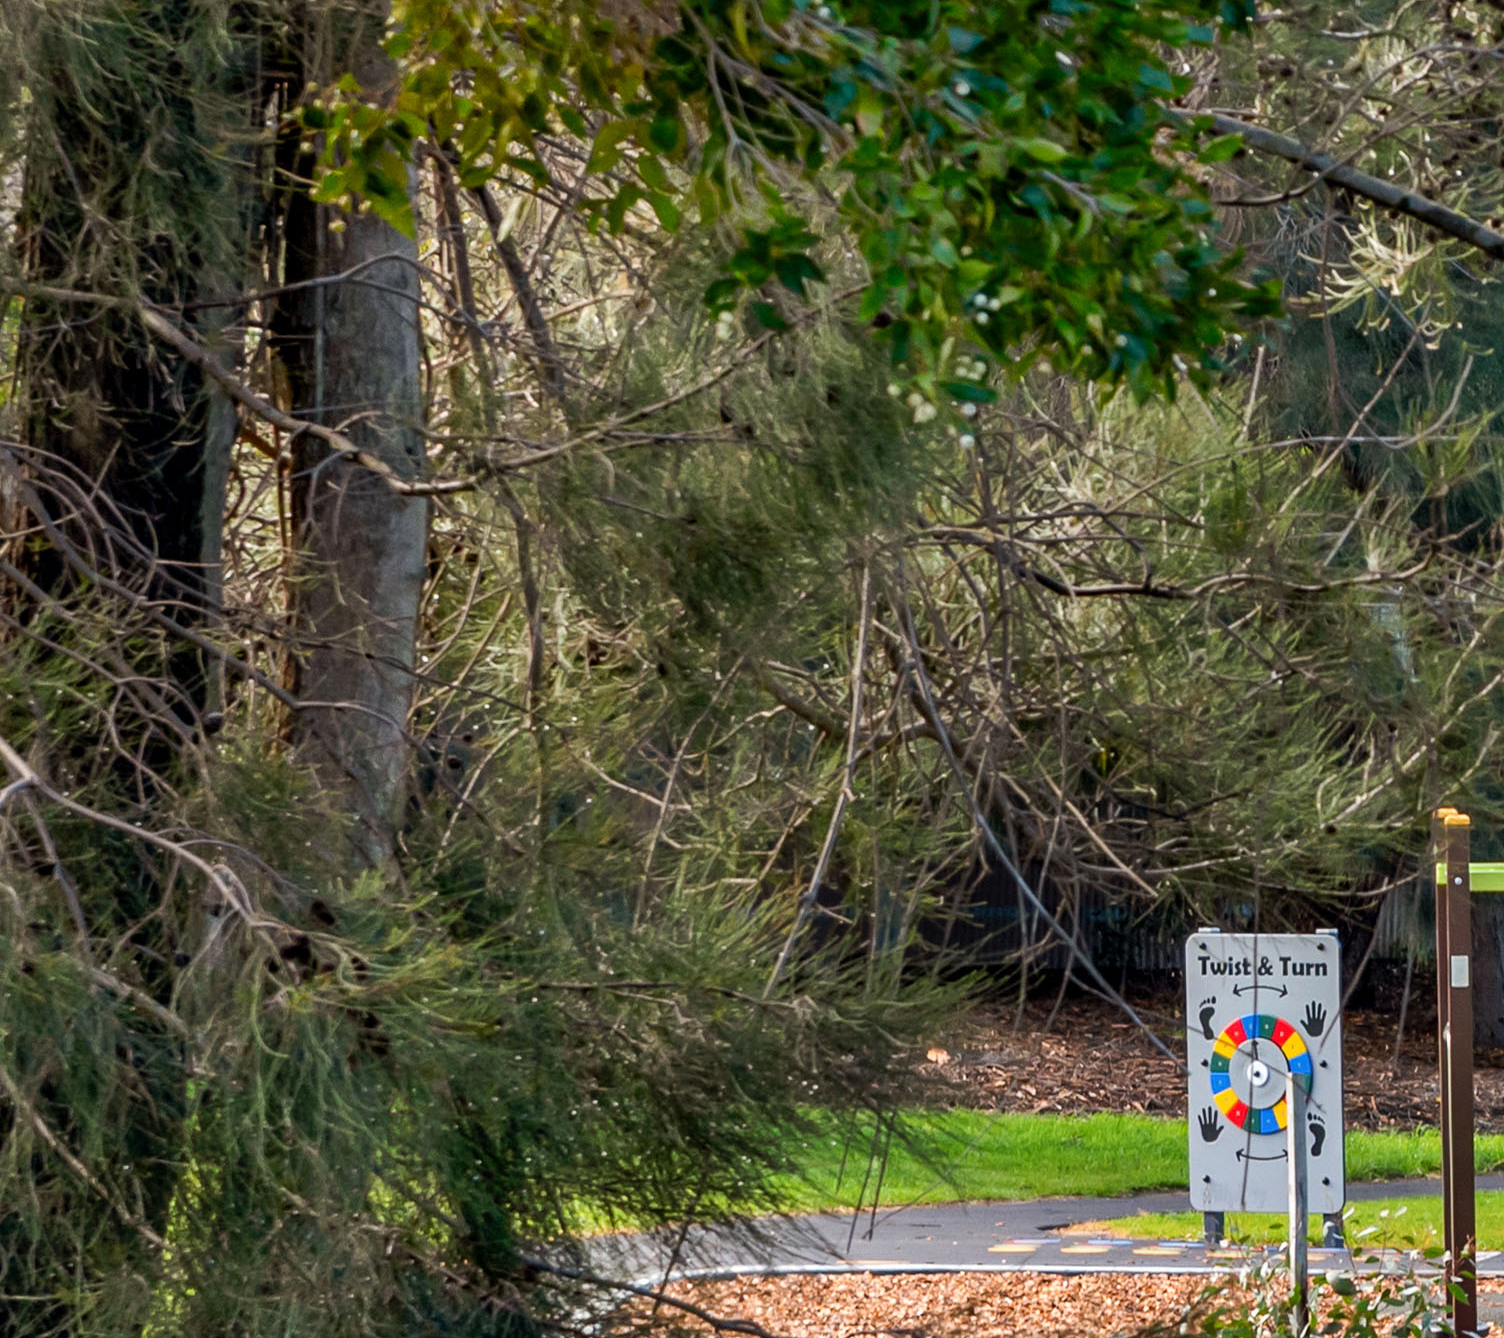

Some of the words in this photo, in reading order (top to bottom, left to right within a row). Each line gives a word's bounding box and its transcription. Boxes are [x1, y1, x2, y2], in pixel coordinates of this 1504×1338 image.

[1197, 955, 1252, 977] Twist
[1257, 956, 1274, 977] &
[1279, 956, 1328, 977] Turn
